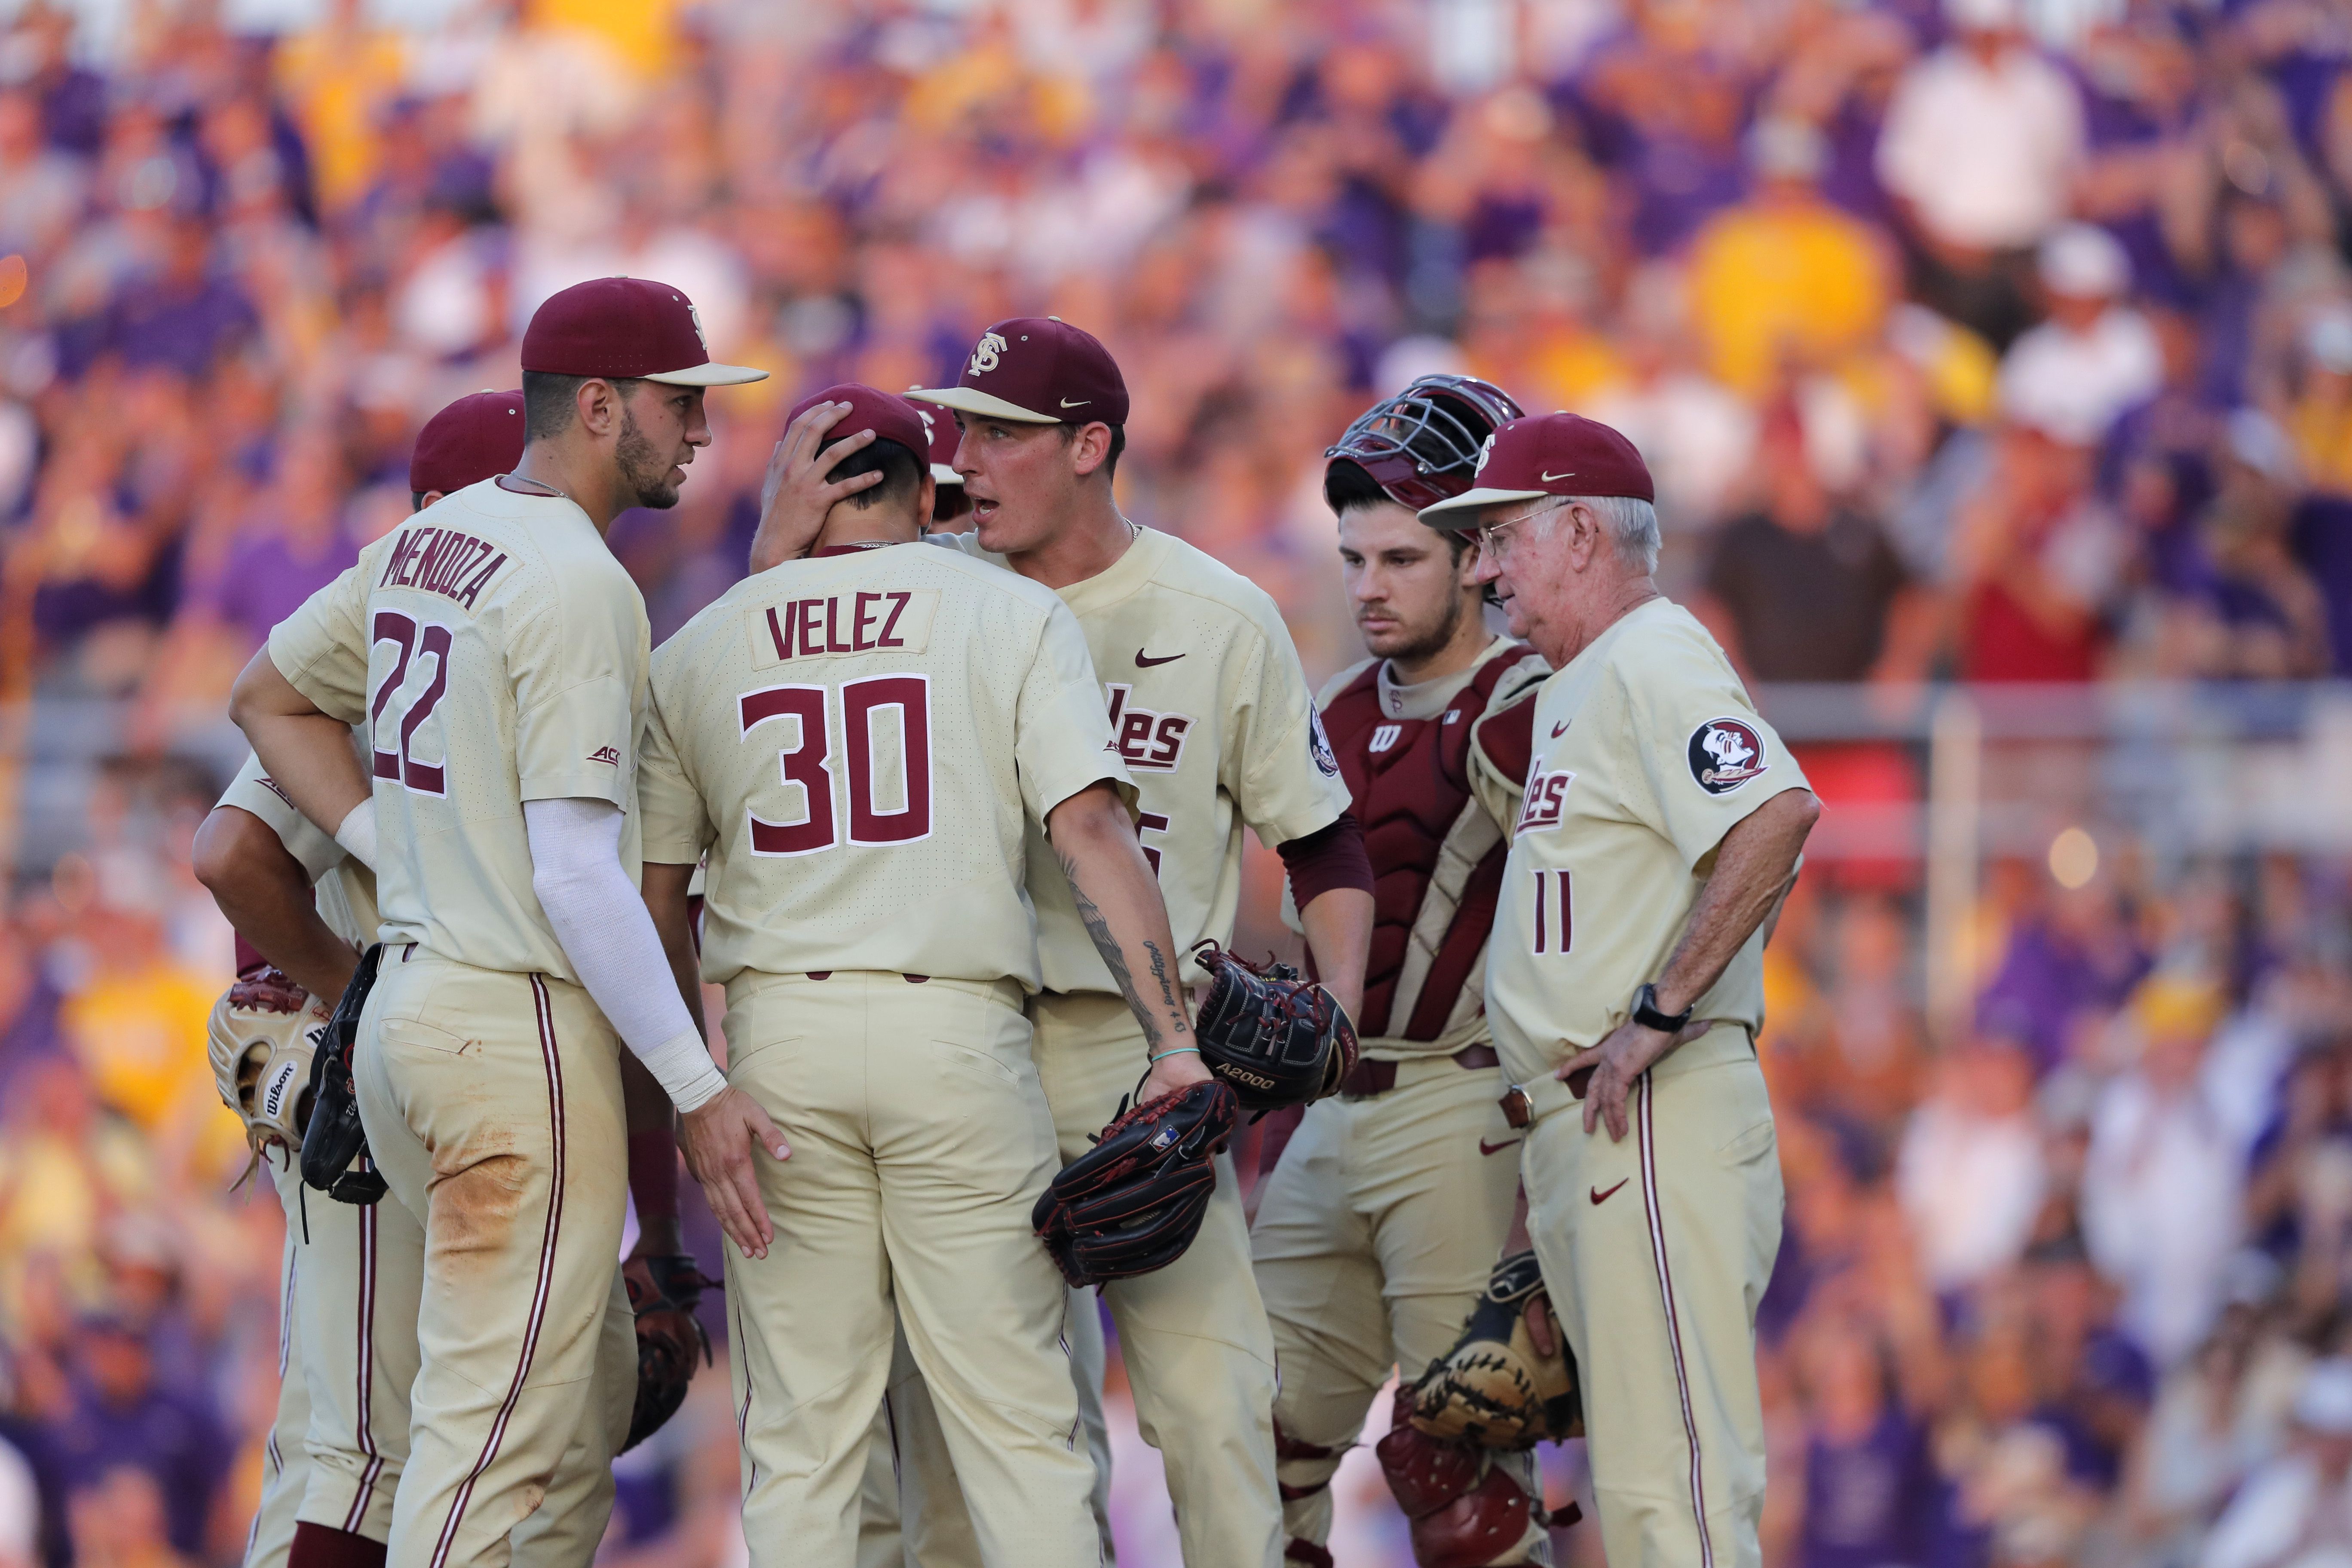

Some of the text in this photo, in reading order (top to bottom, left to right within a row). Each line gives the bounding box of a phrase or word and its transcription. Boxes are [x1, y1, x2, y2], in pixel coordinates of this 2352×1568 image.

[379, 527, 508, 611] MENDOZA
[766, 592, 911, 660] VELEZ
[370, 607, 454, 799] 22
[736, 672, 933, 858] 30
[1529, 868, 1571, 955] 11
[267, 1066, 294, 1115] Wilson
[1216, 1063, 1275, 1089] A2000
